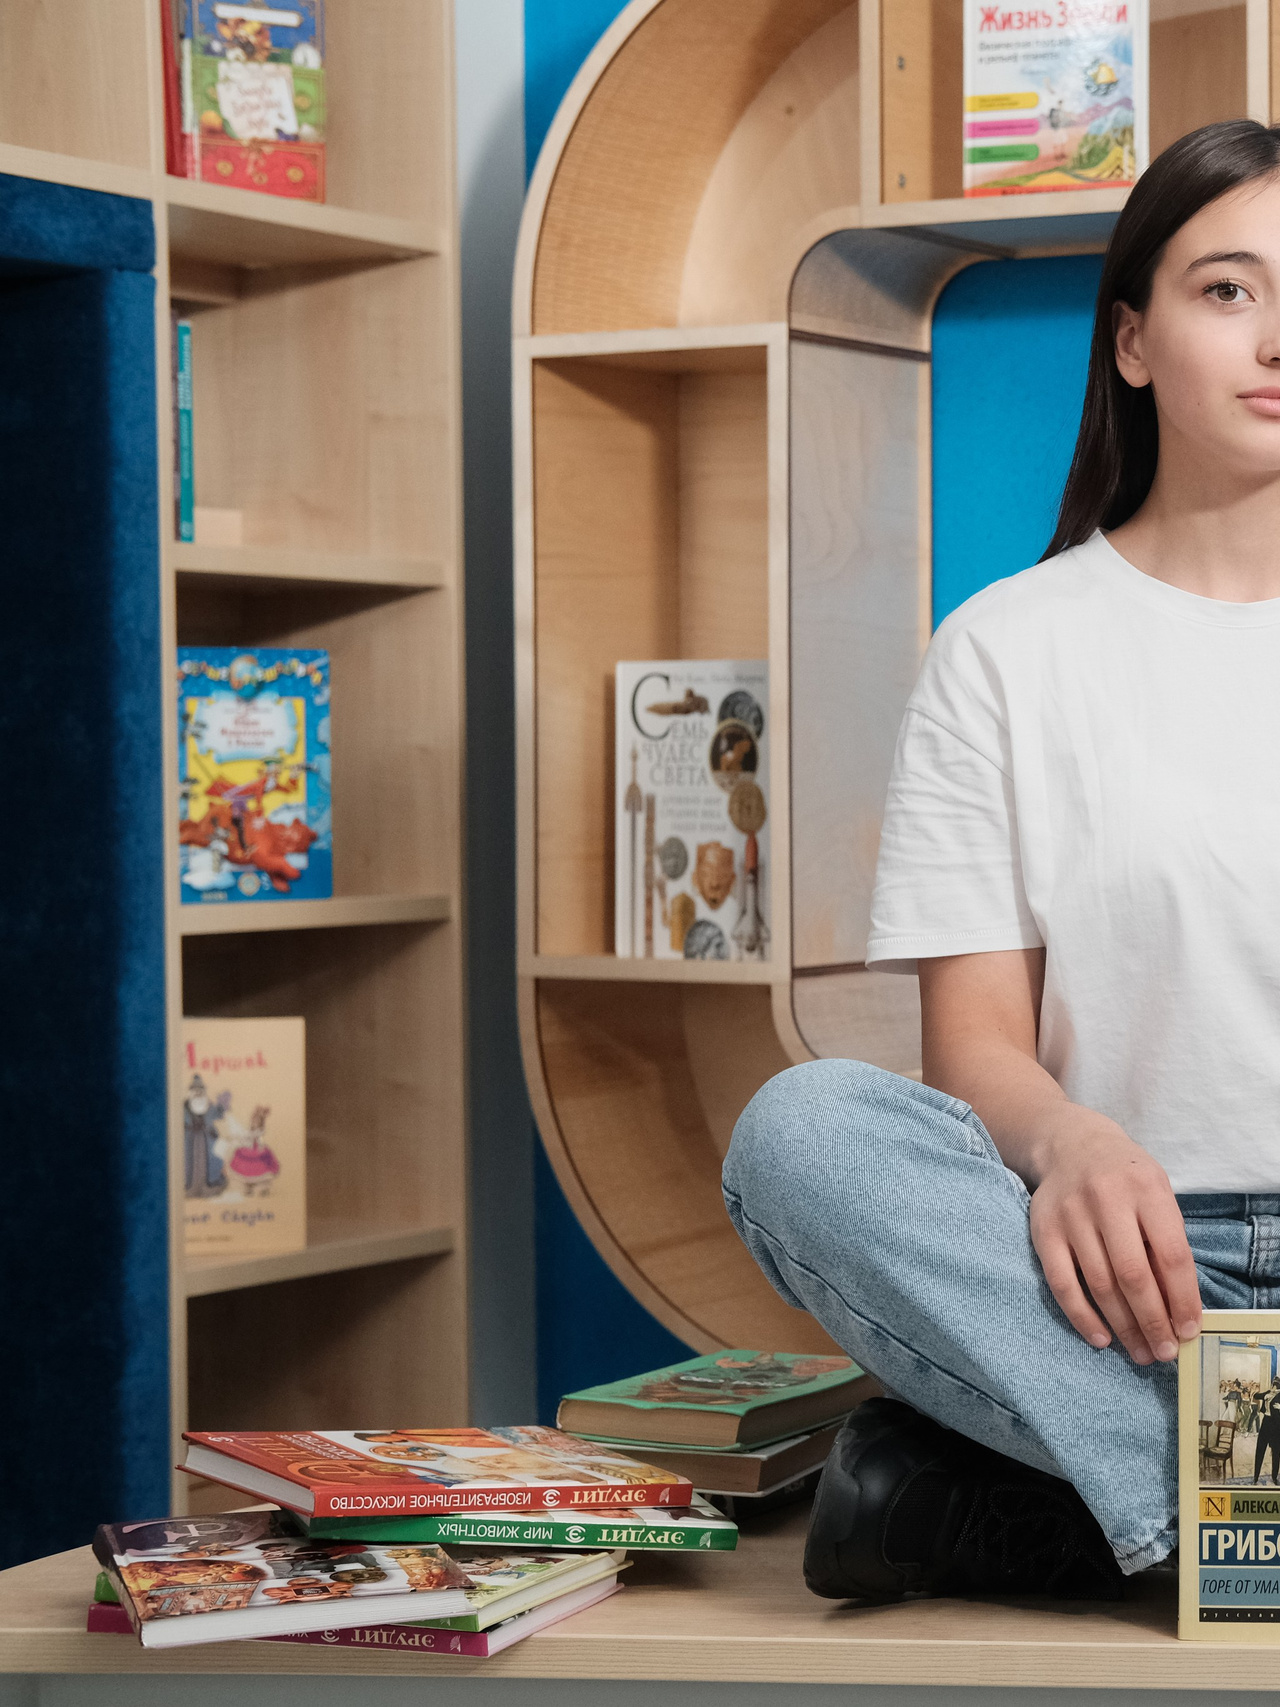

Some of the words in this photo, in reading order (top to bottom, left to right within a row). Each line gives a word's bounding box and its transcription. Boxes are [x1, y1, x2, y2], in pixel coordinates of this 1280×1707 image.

[979, 6, 1052, 32] Жизнь
[649, 765, 709, 786] СВЕТА
[329, 1494, 406, 1510] ИСКУССТВО
[409, 1492, 532, 1508] ИЗОБРАЗИТЕЛЬНОЕ
[570, 1488, 647, 1505] ЭРУДИТ
[437, 1522, 520, 1539] ЖИВОТНЫХ
[523, 1526, 553, 1540] МИР
[597, 1528, 686, 1545] ЭРУДИТ
[1202, 1579, 1233, 1594] ГОРЕ
[1235, 1580, 1252, 1594] ОТ
[1253, 1580, 1280, 1595] УМА
[1202, 1611, 1275, 1620] русская
[351, 1628, 434, 1649] ЭРУДИТ
